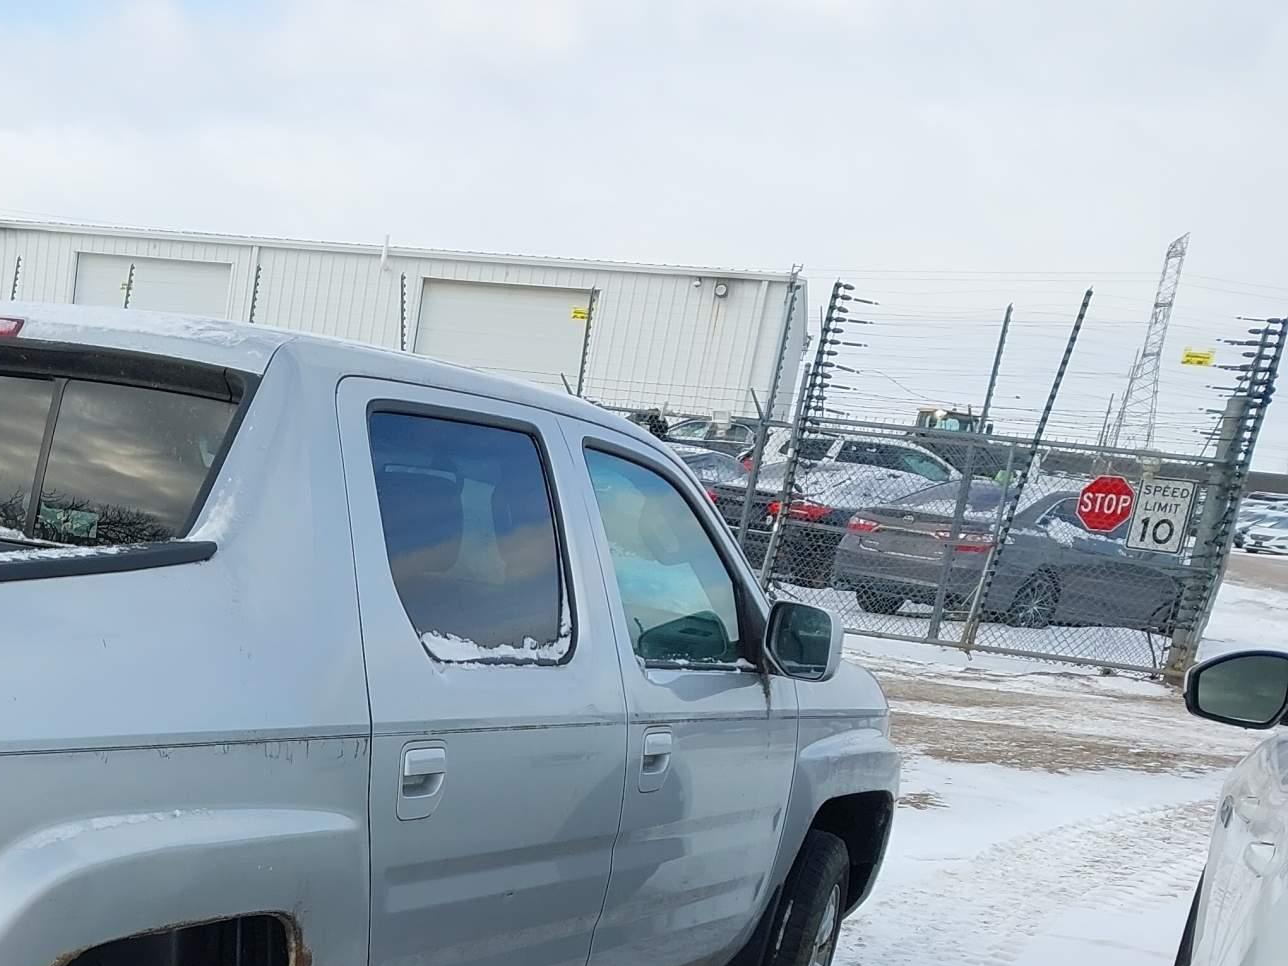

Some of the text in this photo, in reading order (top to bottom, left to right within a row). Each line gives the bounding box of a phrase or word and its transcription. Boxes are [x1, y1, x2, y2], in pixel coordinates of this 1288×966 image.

[1143, 484, 1190, 499] SPEED
[1080, 492, 1131, 515] STOP
[1144, 502, 1181, 514] LIMIT
[1139, 517, 1174, 545] 10
